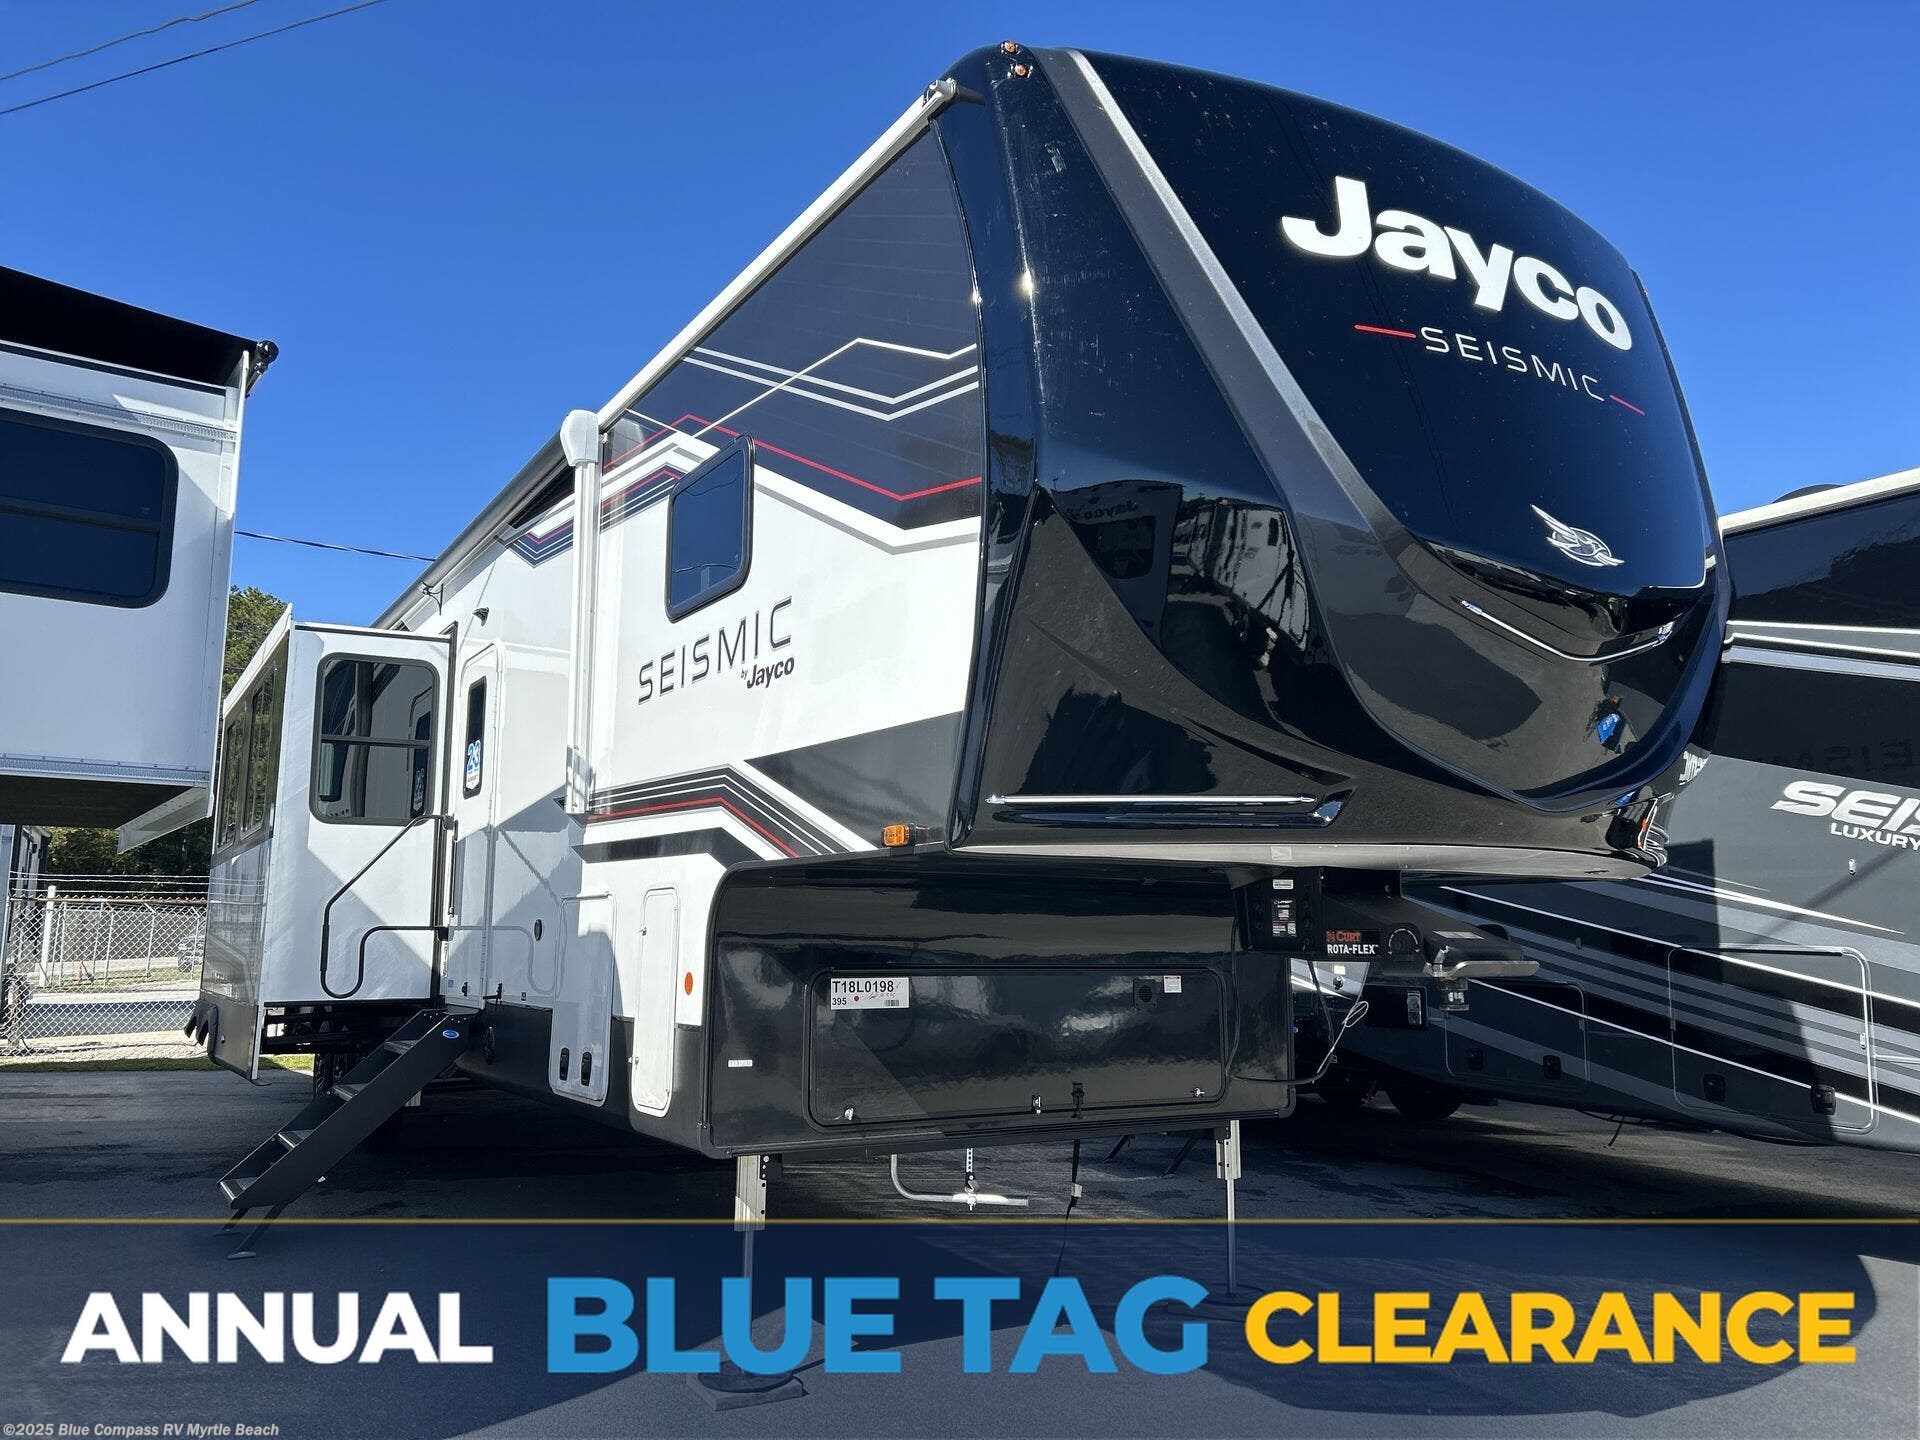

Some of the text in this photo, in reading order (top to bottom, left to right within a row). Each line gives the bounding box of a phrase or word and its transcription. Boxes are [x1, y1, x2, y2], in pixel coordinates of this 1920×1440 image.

[1281, 176, 1632, 351] Jayco
[1420, 326, 1605, 402] SEISMIC
[638, 596, 793, 705] SEISMIC
[746, 656, 795, 689] Jayco
[1830, 822, 1920, 851] LUXURY
[832, 980, 894, 993] T18L0198
[832, 997, 847, 1006] 395
